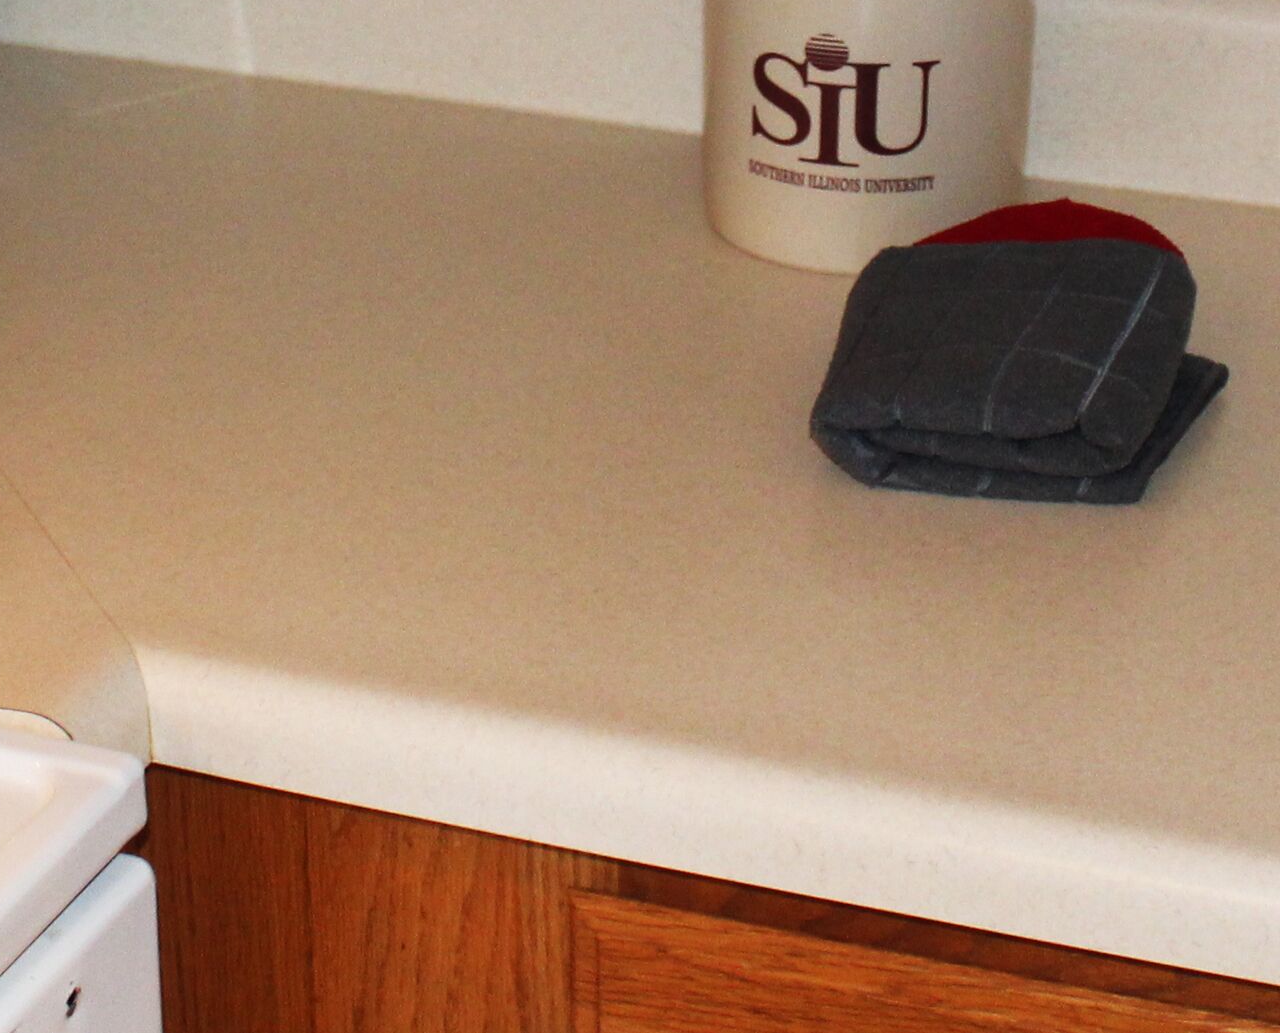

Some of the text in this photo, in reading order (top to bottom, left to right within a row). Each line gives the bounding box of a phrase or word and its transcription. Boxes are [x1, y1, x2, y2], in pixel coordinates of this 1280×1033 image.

[752, 50, 941, 168] SIU
[749, 158, 936, 195] SOUTHERN ILLINOIS UNIVERSITY
